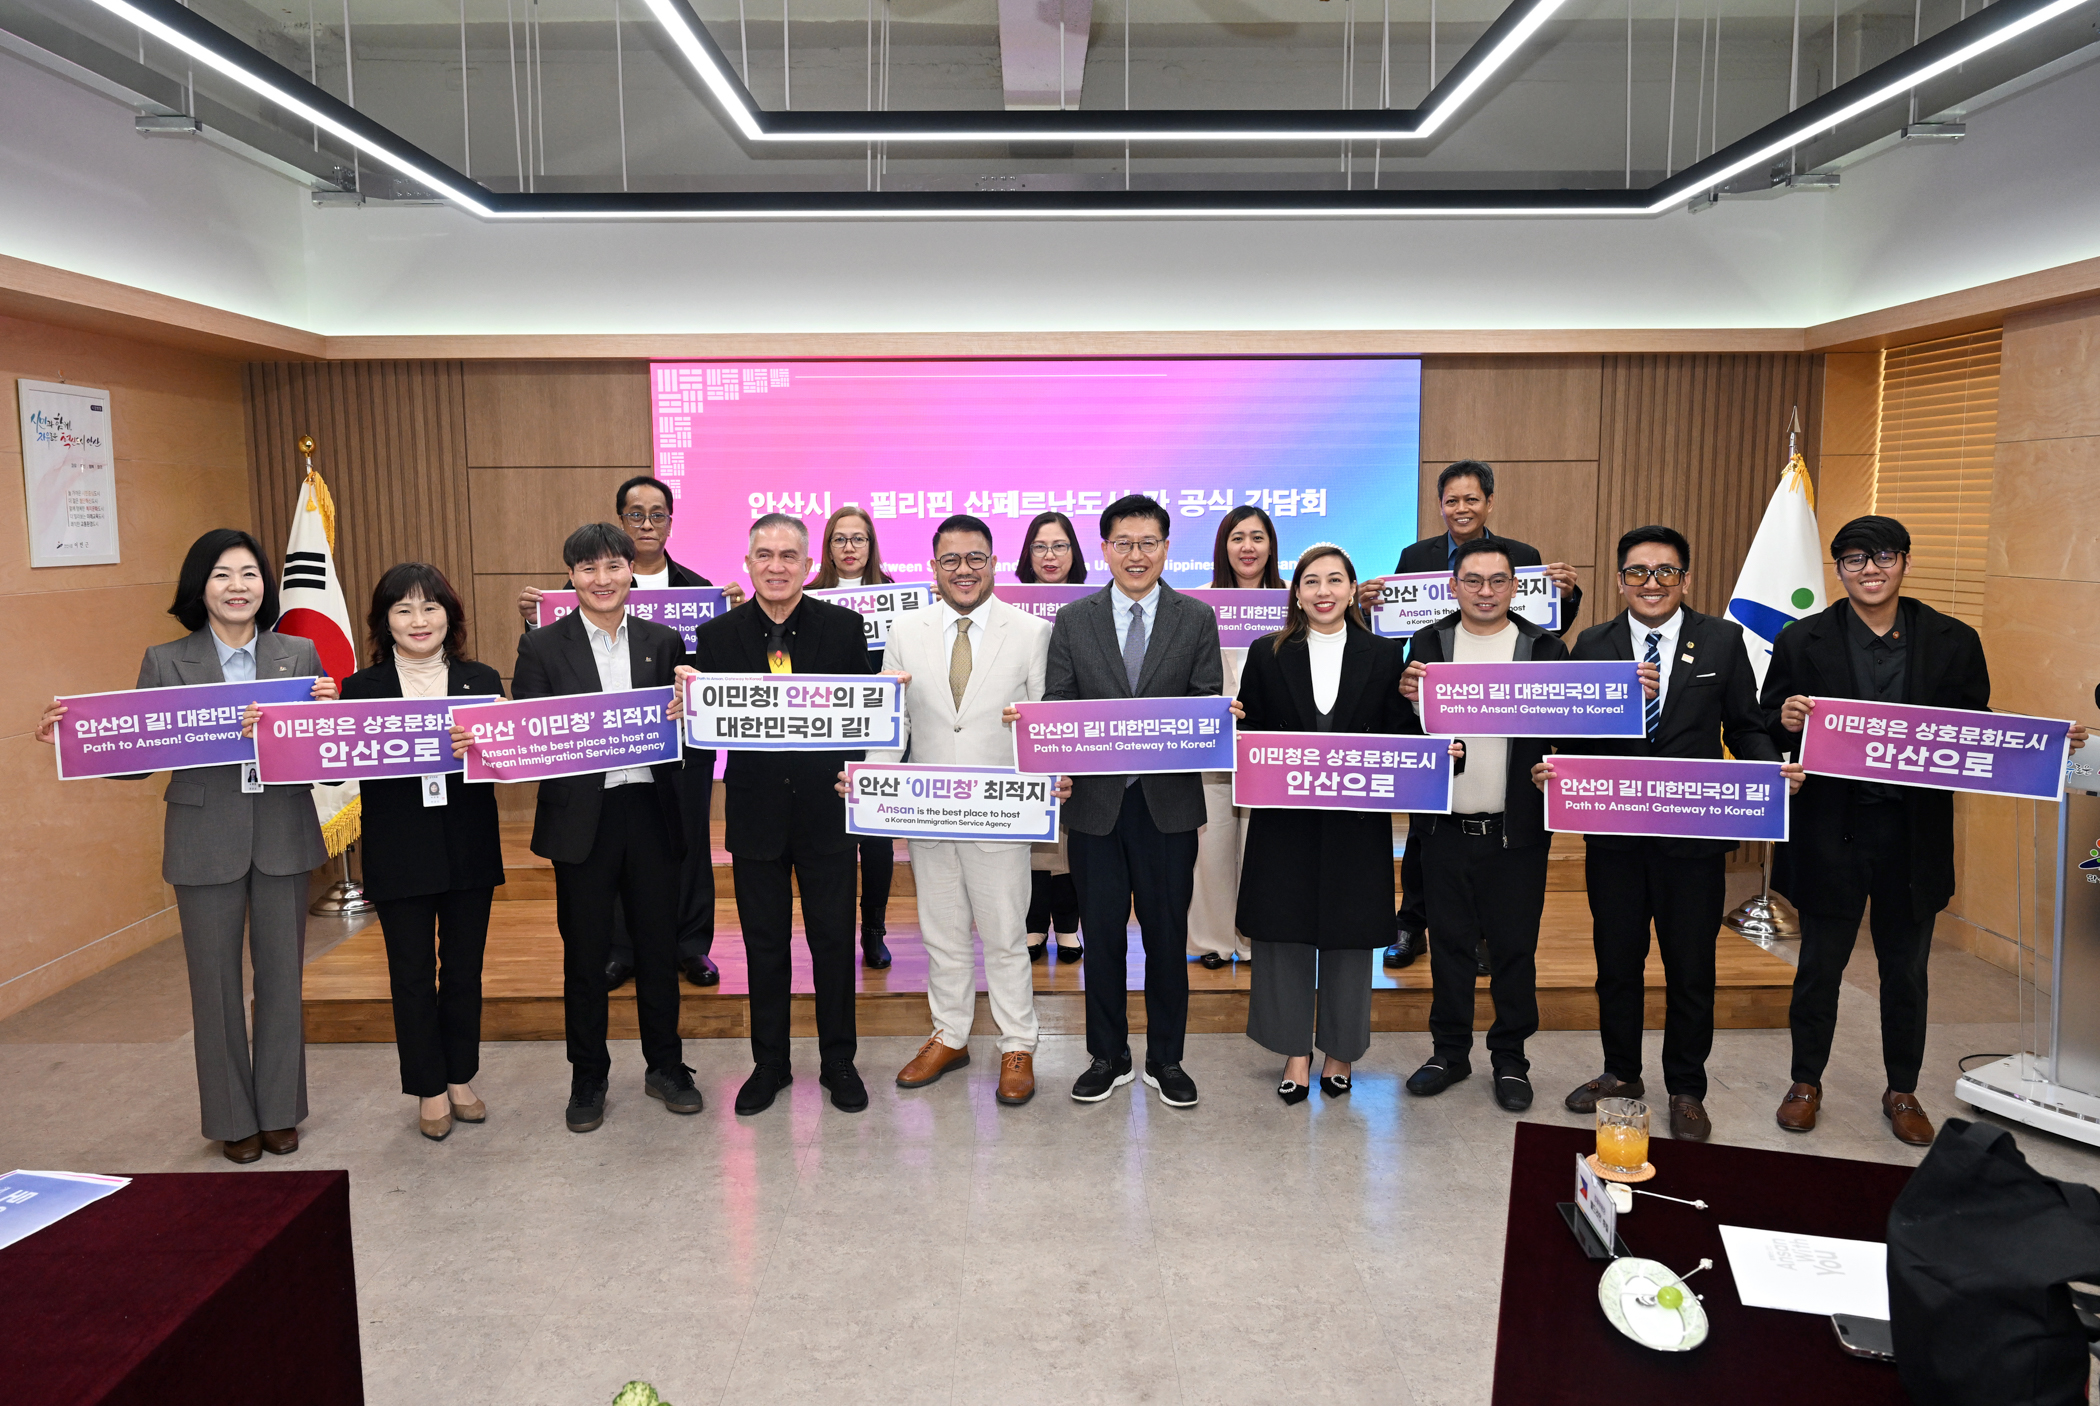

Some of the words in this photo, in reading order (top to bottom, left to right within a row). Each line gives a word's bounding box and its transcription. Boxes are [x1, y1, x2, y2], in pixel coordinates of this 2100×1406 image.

[748, 491, 831, 519] 안산시
[870, 490, 954, 519] 필리핀
[1178, 488, 1234, 517] 공식
[1245, 487, 1328, 517] 간담회
[901, 592, 919, 610] 길
[1382, 585, 1418, 603] 안산
[1516, 578, 1547, 596] 적지
[664, 602, 715, 619] 최적지
[1220, 606, 1237, 619] 길!
[1399, 608, 1432, 617] Ansan
[1218, 623, 1242, 631] nsan!
[702, 685, 779, 708] 이민청!
[785, 686, 854, 709] 안산의
[862, 687, 884, 708] 길
[1435, 683, 1484, 700] 안산의
[1488, 683, 1510, 700] 길!
[1515, 682, 1600, 700] 대한민국의
[1605, 682, 1628, 700] 길!
[1440, 704, 1466, 714] Path
[1467, 705, 1478, 714] to
[1480, 704, 1518, 714] Ansan!
[1519, 705, 1570, 716] Gateway
[1572, 705, 1584, 714] to
[1586, 704, 1624, 714] Korea!
[75, 714, 140, 739] 안산의
[145, 712, 172, 732] 길!
[273, 716, 356, 738] 이민청은
[471, 720, 515, 744] 안산
[521, 711, 595, 738] ‘이민청’
[603, 704, 662, 730] 최적지
[716, 716, 832, 739] 대한민국의
[841, 716, 871, 738] 길!
[1028, 721, 1079, 739] 안산의
[1083, 721, 1105, 738] 길!
[1109, 718, 1193, 737] 대한민국의
[1198, 718, 1220, 734] 길!
[1824, 713, 1909, 739] 이민청은
[1915, 722, 2049, 751] 상호문화도시
[83, 740, 116, 753] Path
[118, 740, 133, 750] to
[136, 734, 182, 748] Ansan!
[185, 730, 242, 744] Gateway
[318, 737, 441, 768] 안산으로
[481, 748, 516, 760] Ansan
[517, 745, 527, 755] is
[530, 742, 548, 753] the
[550, 740, 574, 751] best
[577, 736, 607, 750] place
[608, 736, 619, 745] to
[622, 733, 644, 744] host
[646, 731, 660, 740] an
[1034, 743, 1059, 753] Path
[1061, 744, 1073, 752] to
[1075, 742, 1113, 752] Ansan!
[1115, 741, 1164, 752] Gateway
[1166, 741, 1178, 750] to
[1180, 739, 1216, 749] Korea!
[518, 752, 584, 768] Immigration
[586, 746, 626, 759] Service
[628, 742, 666, 754] Agency
[1249, 747, 1321, 766] 이민청은
[1326, 748, 1436, 770] 상호문화도시
[1865, 741, 1995, 778] 안산으로
[858, 776, 900, 797] 안산
[905, 777, 978, 800] ‘이민청’
[983, 780, 1046, 802] 최적지
[1286, 770, 1395, 798] 안산으로
[1560, 778, 1613, 796] 안산의
[1618, 780, 1642, 797] 길!
[1647, 781, 1739, 800] 대한민국의
[1745, 783, 1771, 801] 길!
[876, 803, 915, 815] Ansan
[917, 807, 925, 815] is
[926, 807, 941, 816] the
[942, 808, 962, 817] best
[963, 808, 988, 819] place
[990, 810, 999, 818] to
[1000, 810, 1020, 819] host
[1565, 800, 1592, 811] Path
[1594, 801, 1606, 811] to
[1608, 802, 1650, 812] Ansan!
[1652, 803, 1707, 816] Gateway
[1708, 805, 1722, 815] to
[1724, 806, 1765, 817] Korea!
[916, 818, 957, 827] Immigration
[958, 819, 984, 827] Service
[985, 820, 1012, 828] Agency
[1772, 1238, 1798, 1271] Ansan
[1812, 1249, 1846, 1276] You
